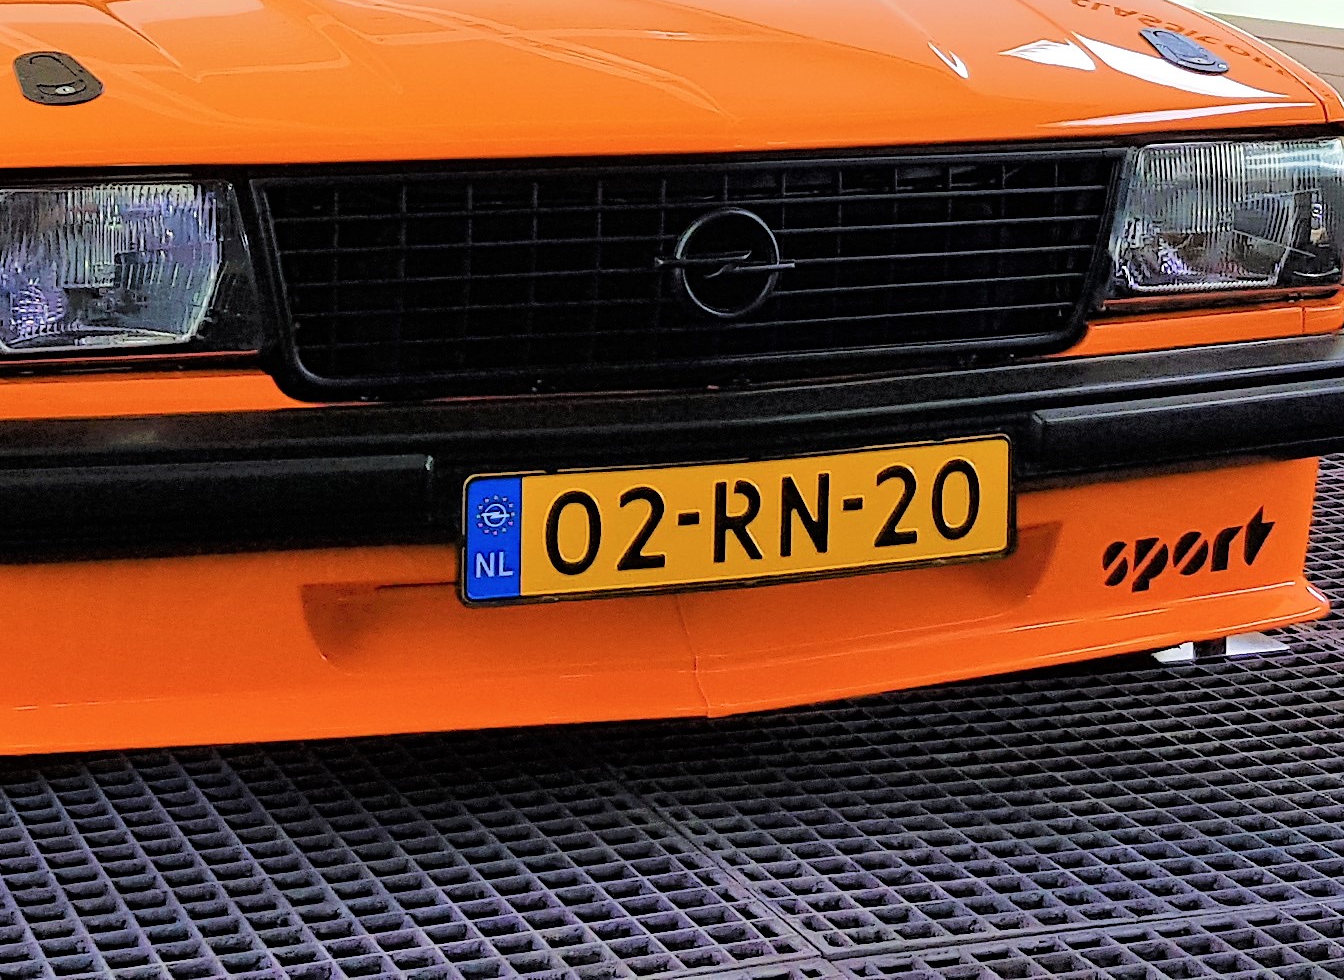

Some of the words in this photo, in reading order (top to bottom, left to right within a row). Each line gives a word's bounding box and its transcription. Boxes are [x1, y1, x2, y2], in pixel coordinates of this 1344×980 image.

[545, 458, 980, 576] 02-RN-20
[1102, 504, 1276, 593] sport
[475, 552, 514, 579] NL
